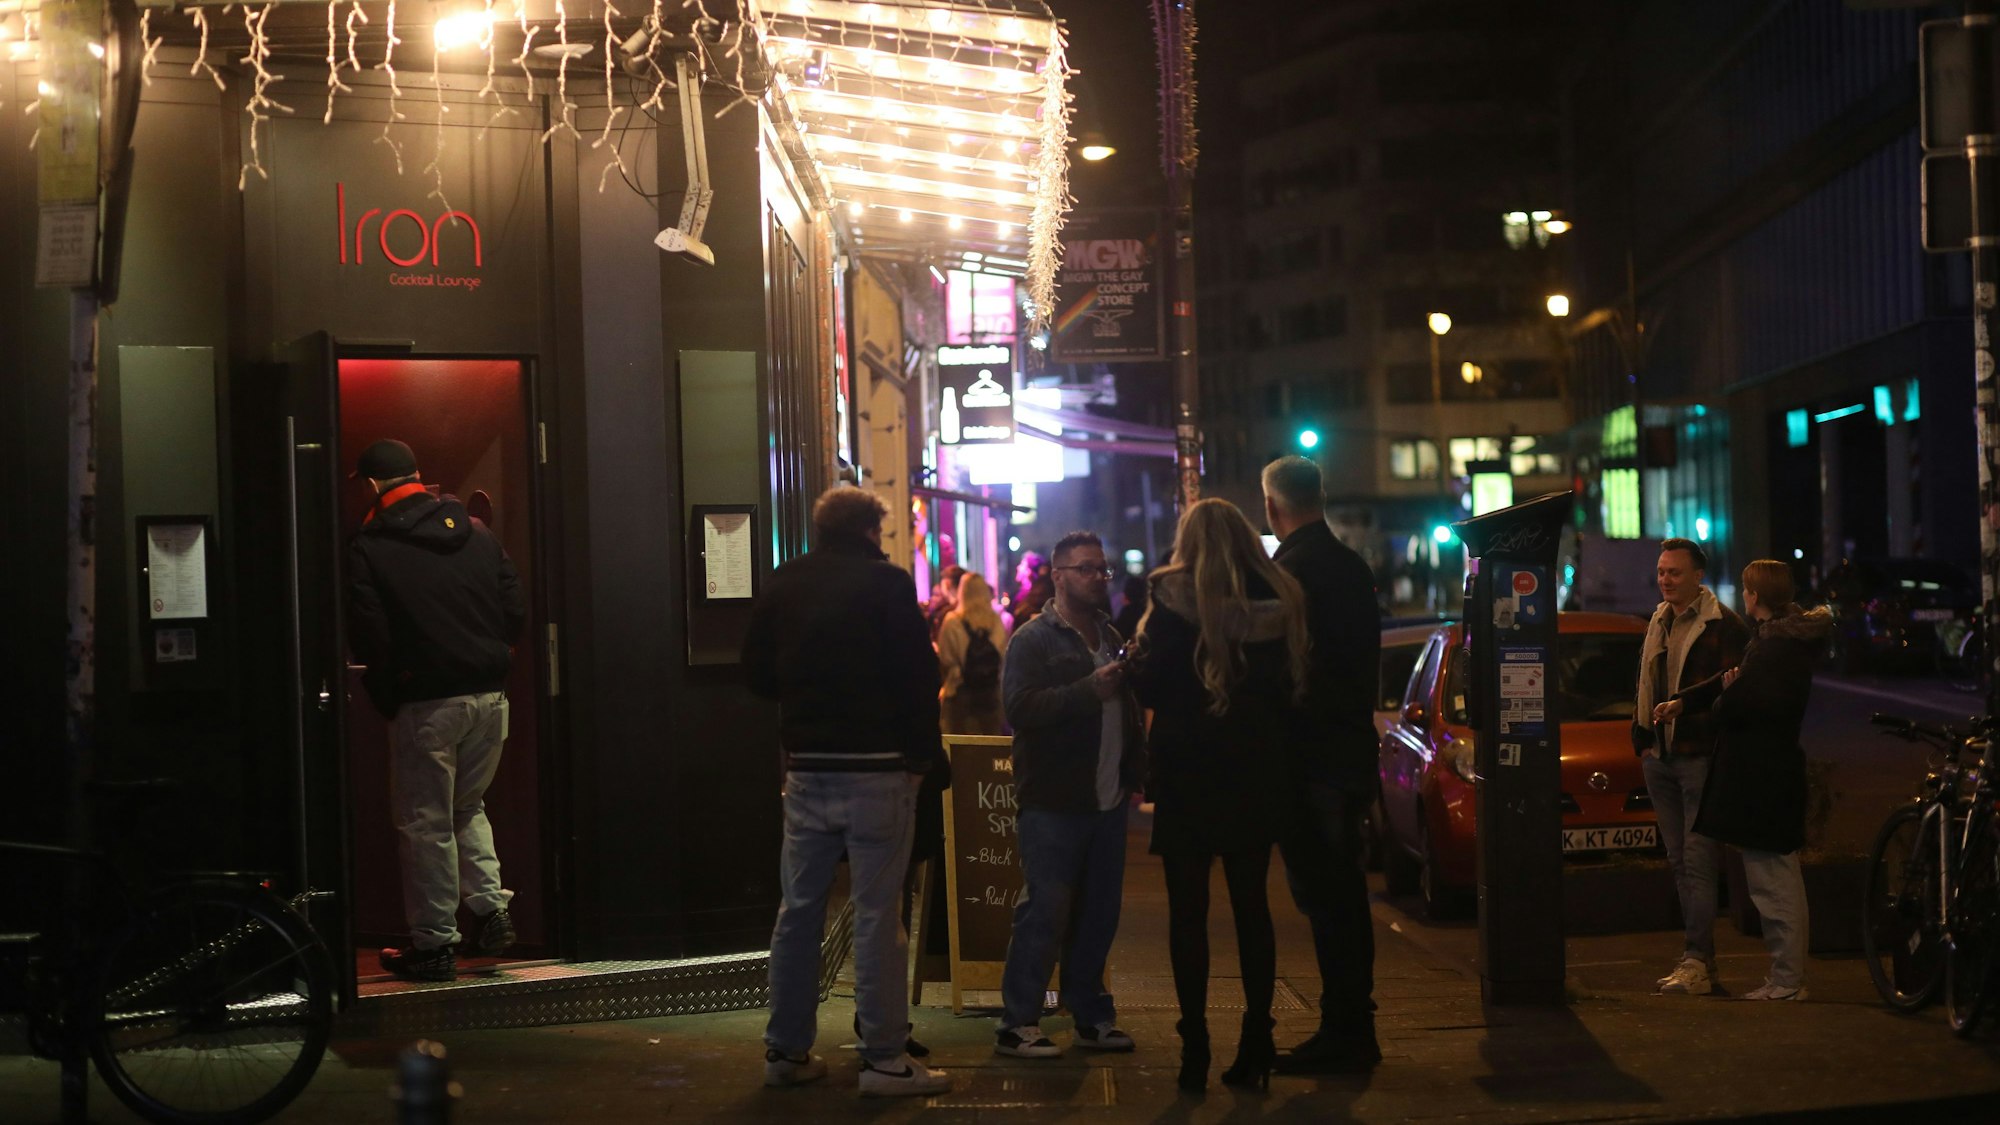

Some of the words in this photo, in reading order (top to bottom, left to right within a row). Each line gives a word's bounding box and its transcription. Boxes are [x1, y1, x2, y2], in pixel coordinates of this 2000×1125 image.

[336, 182, 482, 267] Iron
[1063, 239, 1145, 270] MGW
[389, 272, 434, 286] Cocktail
[437, 274, 481, 291] Lounge
[1096, 271, 1119, 281] THE
[1120, 271, 1144, 281] GAY
[1096, 282, 1150, 294] CONCEPT
[1097, 295, 1134, 305] STORE
[994, 759, 1014, 771] MA
[978, 781, 1019, 809] KAR
[1563, 832, 1574, 848] K
[1586, 830, 1608, 847] KT
[1612, 828, 1654, 846] 4094
[985, 885, 1008, 906] Red
